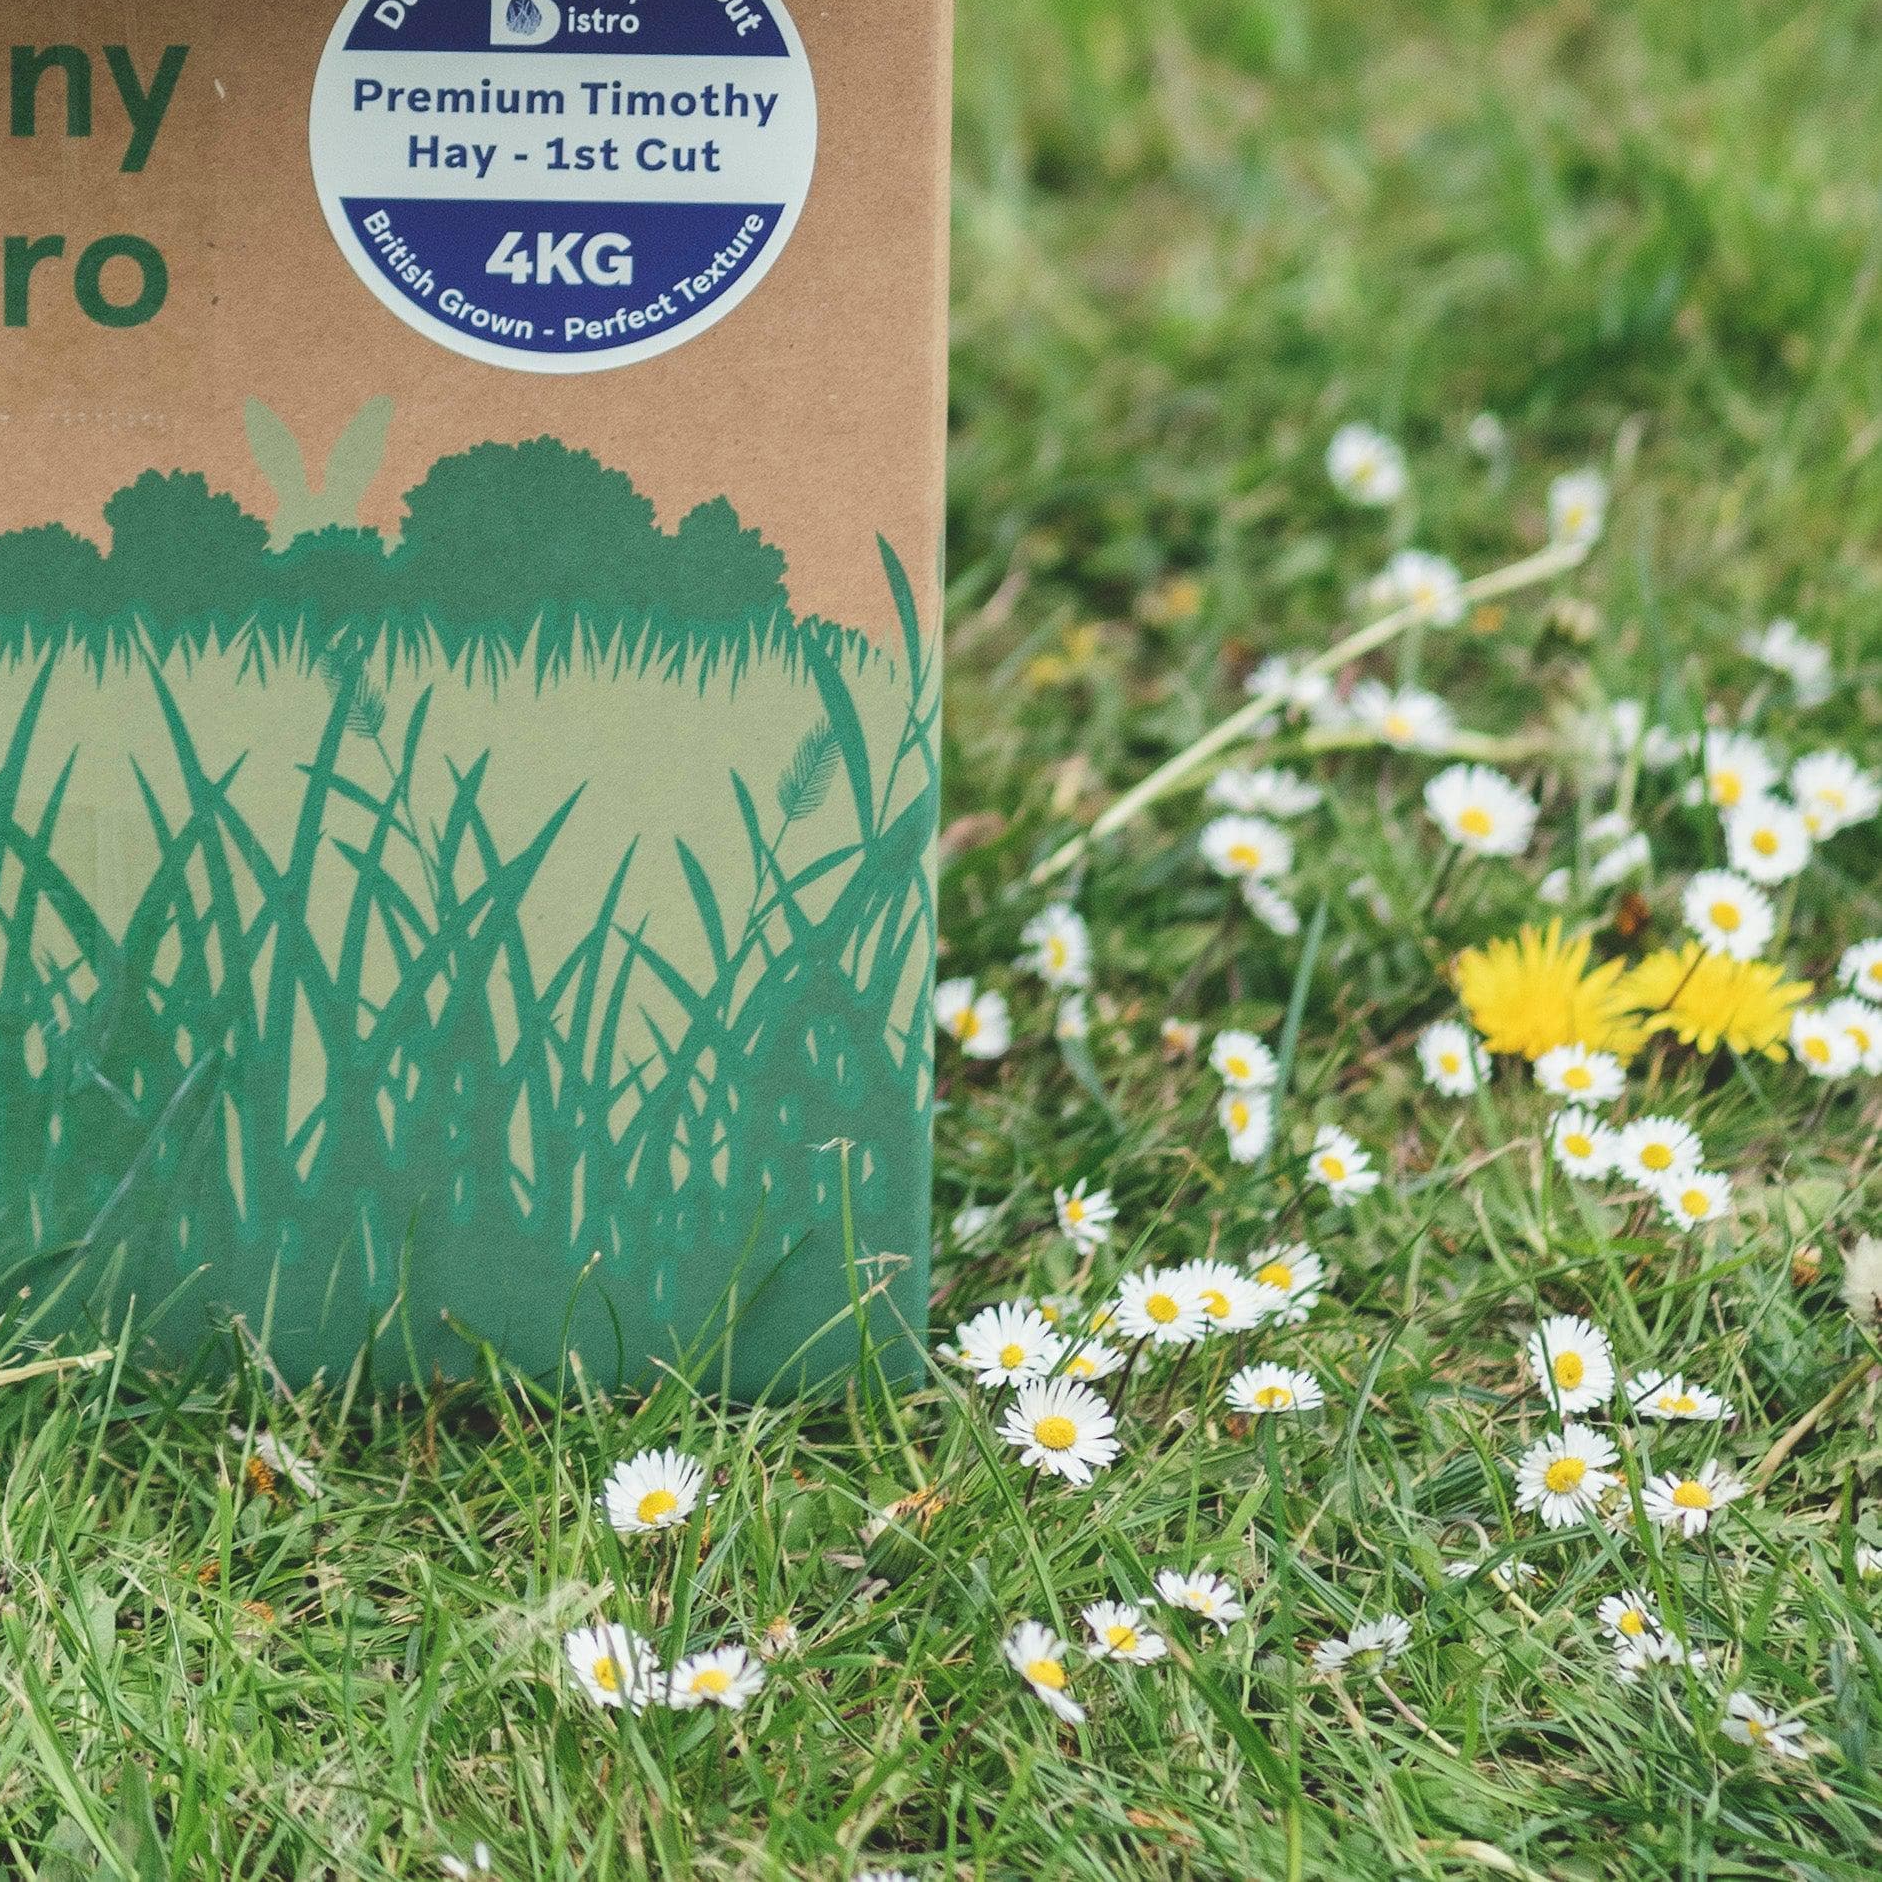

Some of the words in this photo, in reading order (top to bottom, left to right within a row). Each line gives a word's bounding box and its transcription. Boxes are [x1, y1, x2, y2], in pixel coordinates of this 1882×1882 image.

[353, 77, 565, 115] Premium
[579, 79, 779, 128] Timothy
[408, 134, 498, 179] Hay
[545, 136, 620, 172] 1st
[635, 138, 721, 173] Cut
[363, 209, 435, 297] British
[438, 288, 534, 340] Grown
[564, 277, 678, 342] Perfect
[672, 214, 764, 302] Texture
[485, 231, 633, 286] 4KG
